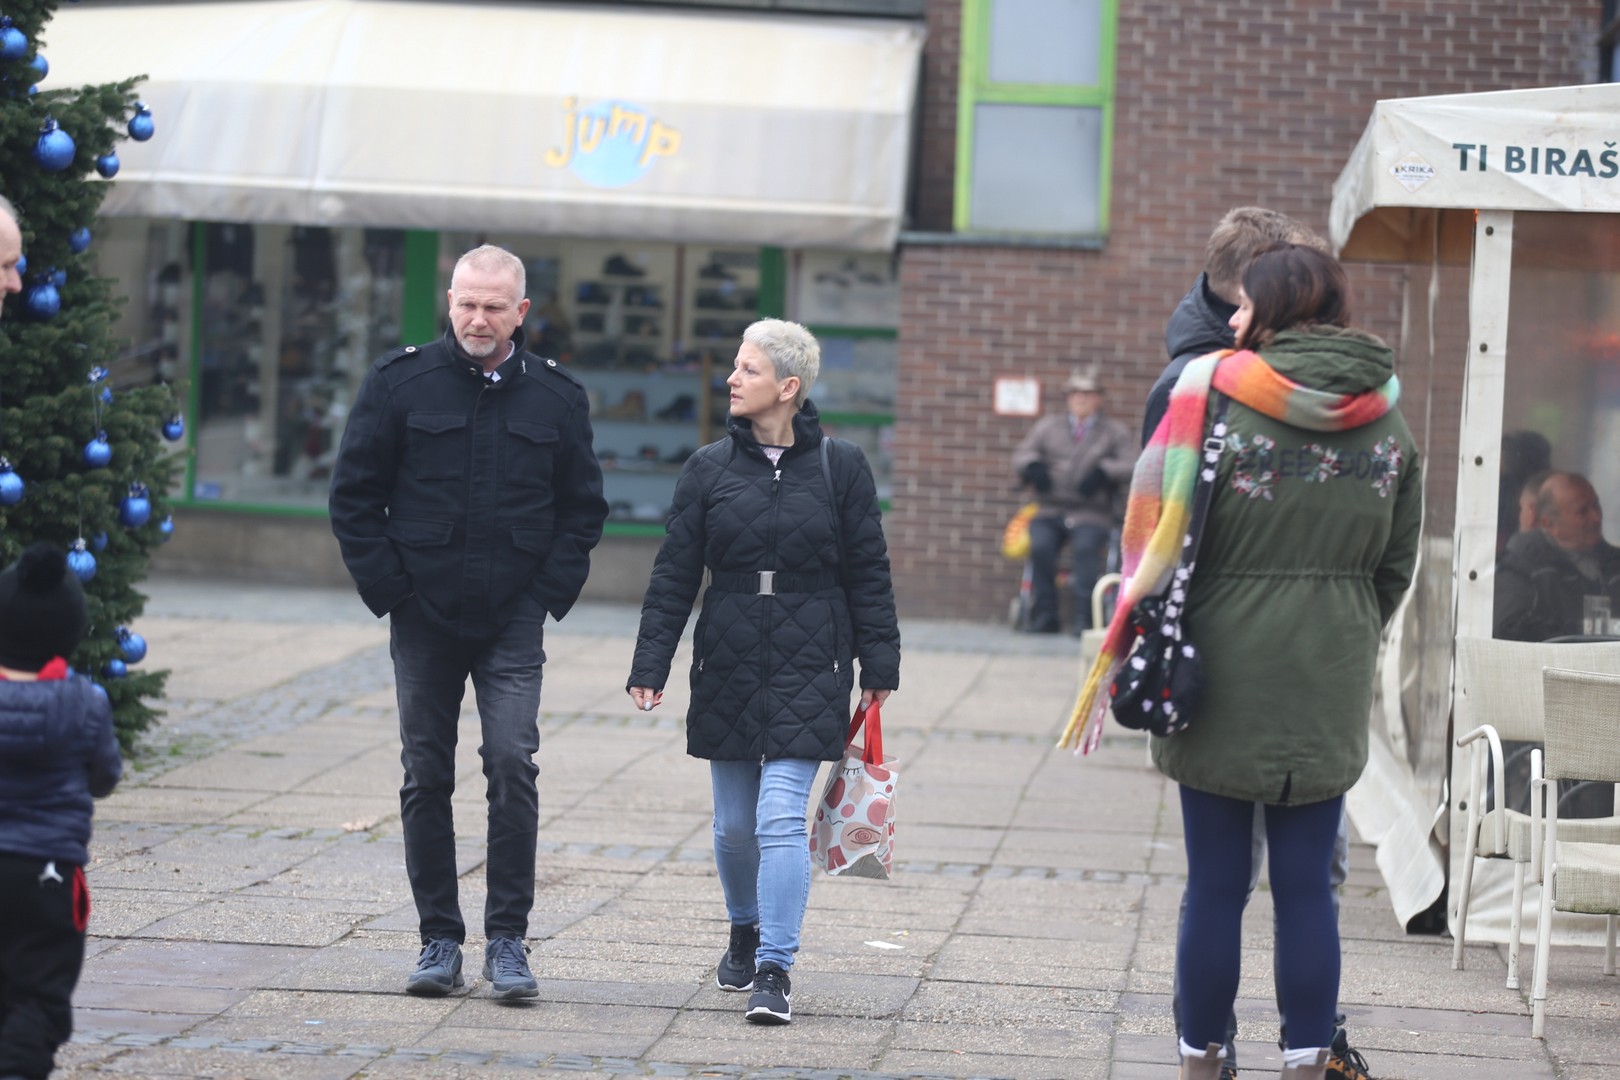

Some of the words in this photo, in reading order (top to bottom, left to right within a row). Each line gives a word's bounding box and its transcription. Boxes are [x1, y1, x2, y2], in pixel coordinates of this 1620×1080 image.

[544, 95, 682, 167] jump
[1452, 143, 1487, 172] TI
[1504, 141, 1619, 179] BIRAŠ
